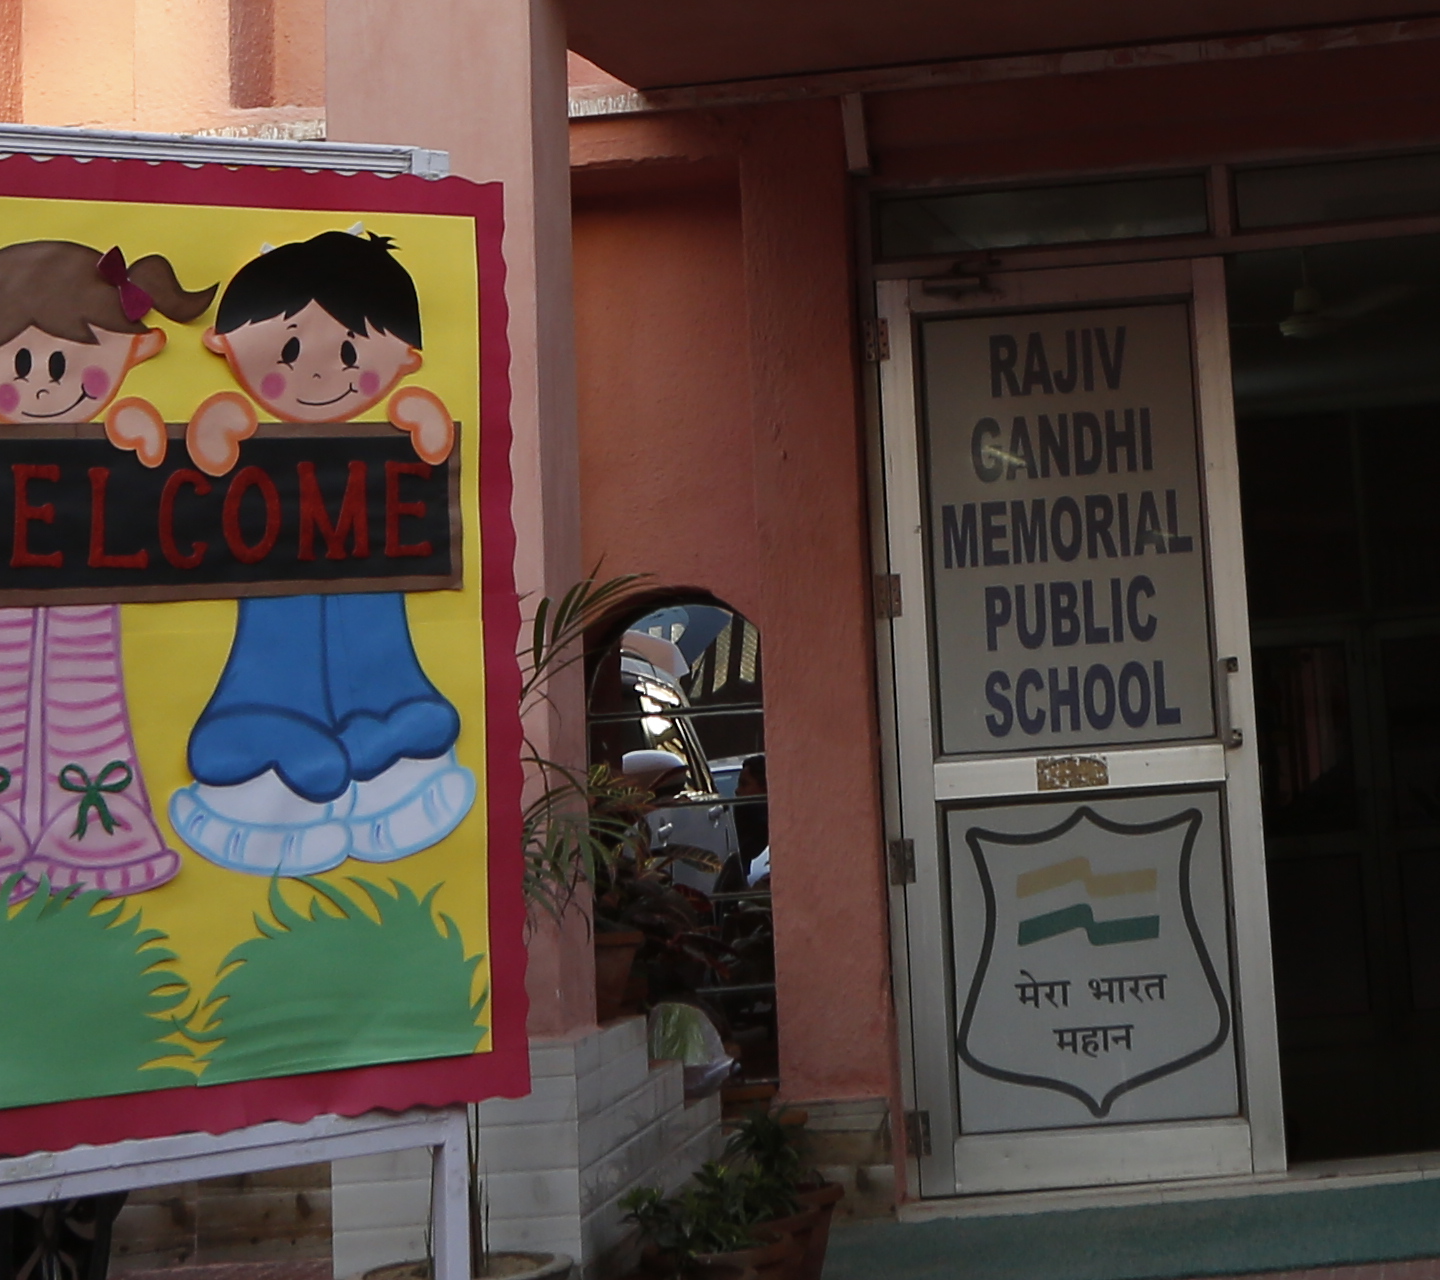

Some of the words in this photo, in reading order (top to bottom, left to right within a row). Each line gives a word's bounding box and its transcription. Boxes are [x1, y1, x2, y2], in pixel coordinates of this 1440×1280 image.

[988, 327, 1126, 399] RAJIV
[970, 408, 1153, 483] GANDHI
[942, 489, 1192, 569] MEMORIAL
[984, 575, 1158, 651] PUBLIC
[984, 660, 1181, 738] SCHOOL
[1014, 969, 1072, 1009] मेरा
[1088, 973, 1167, 1005] भारत
[1053, 1024, 1134, 1055] महान
